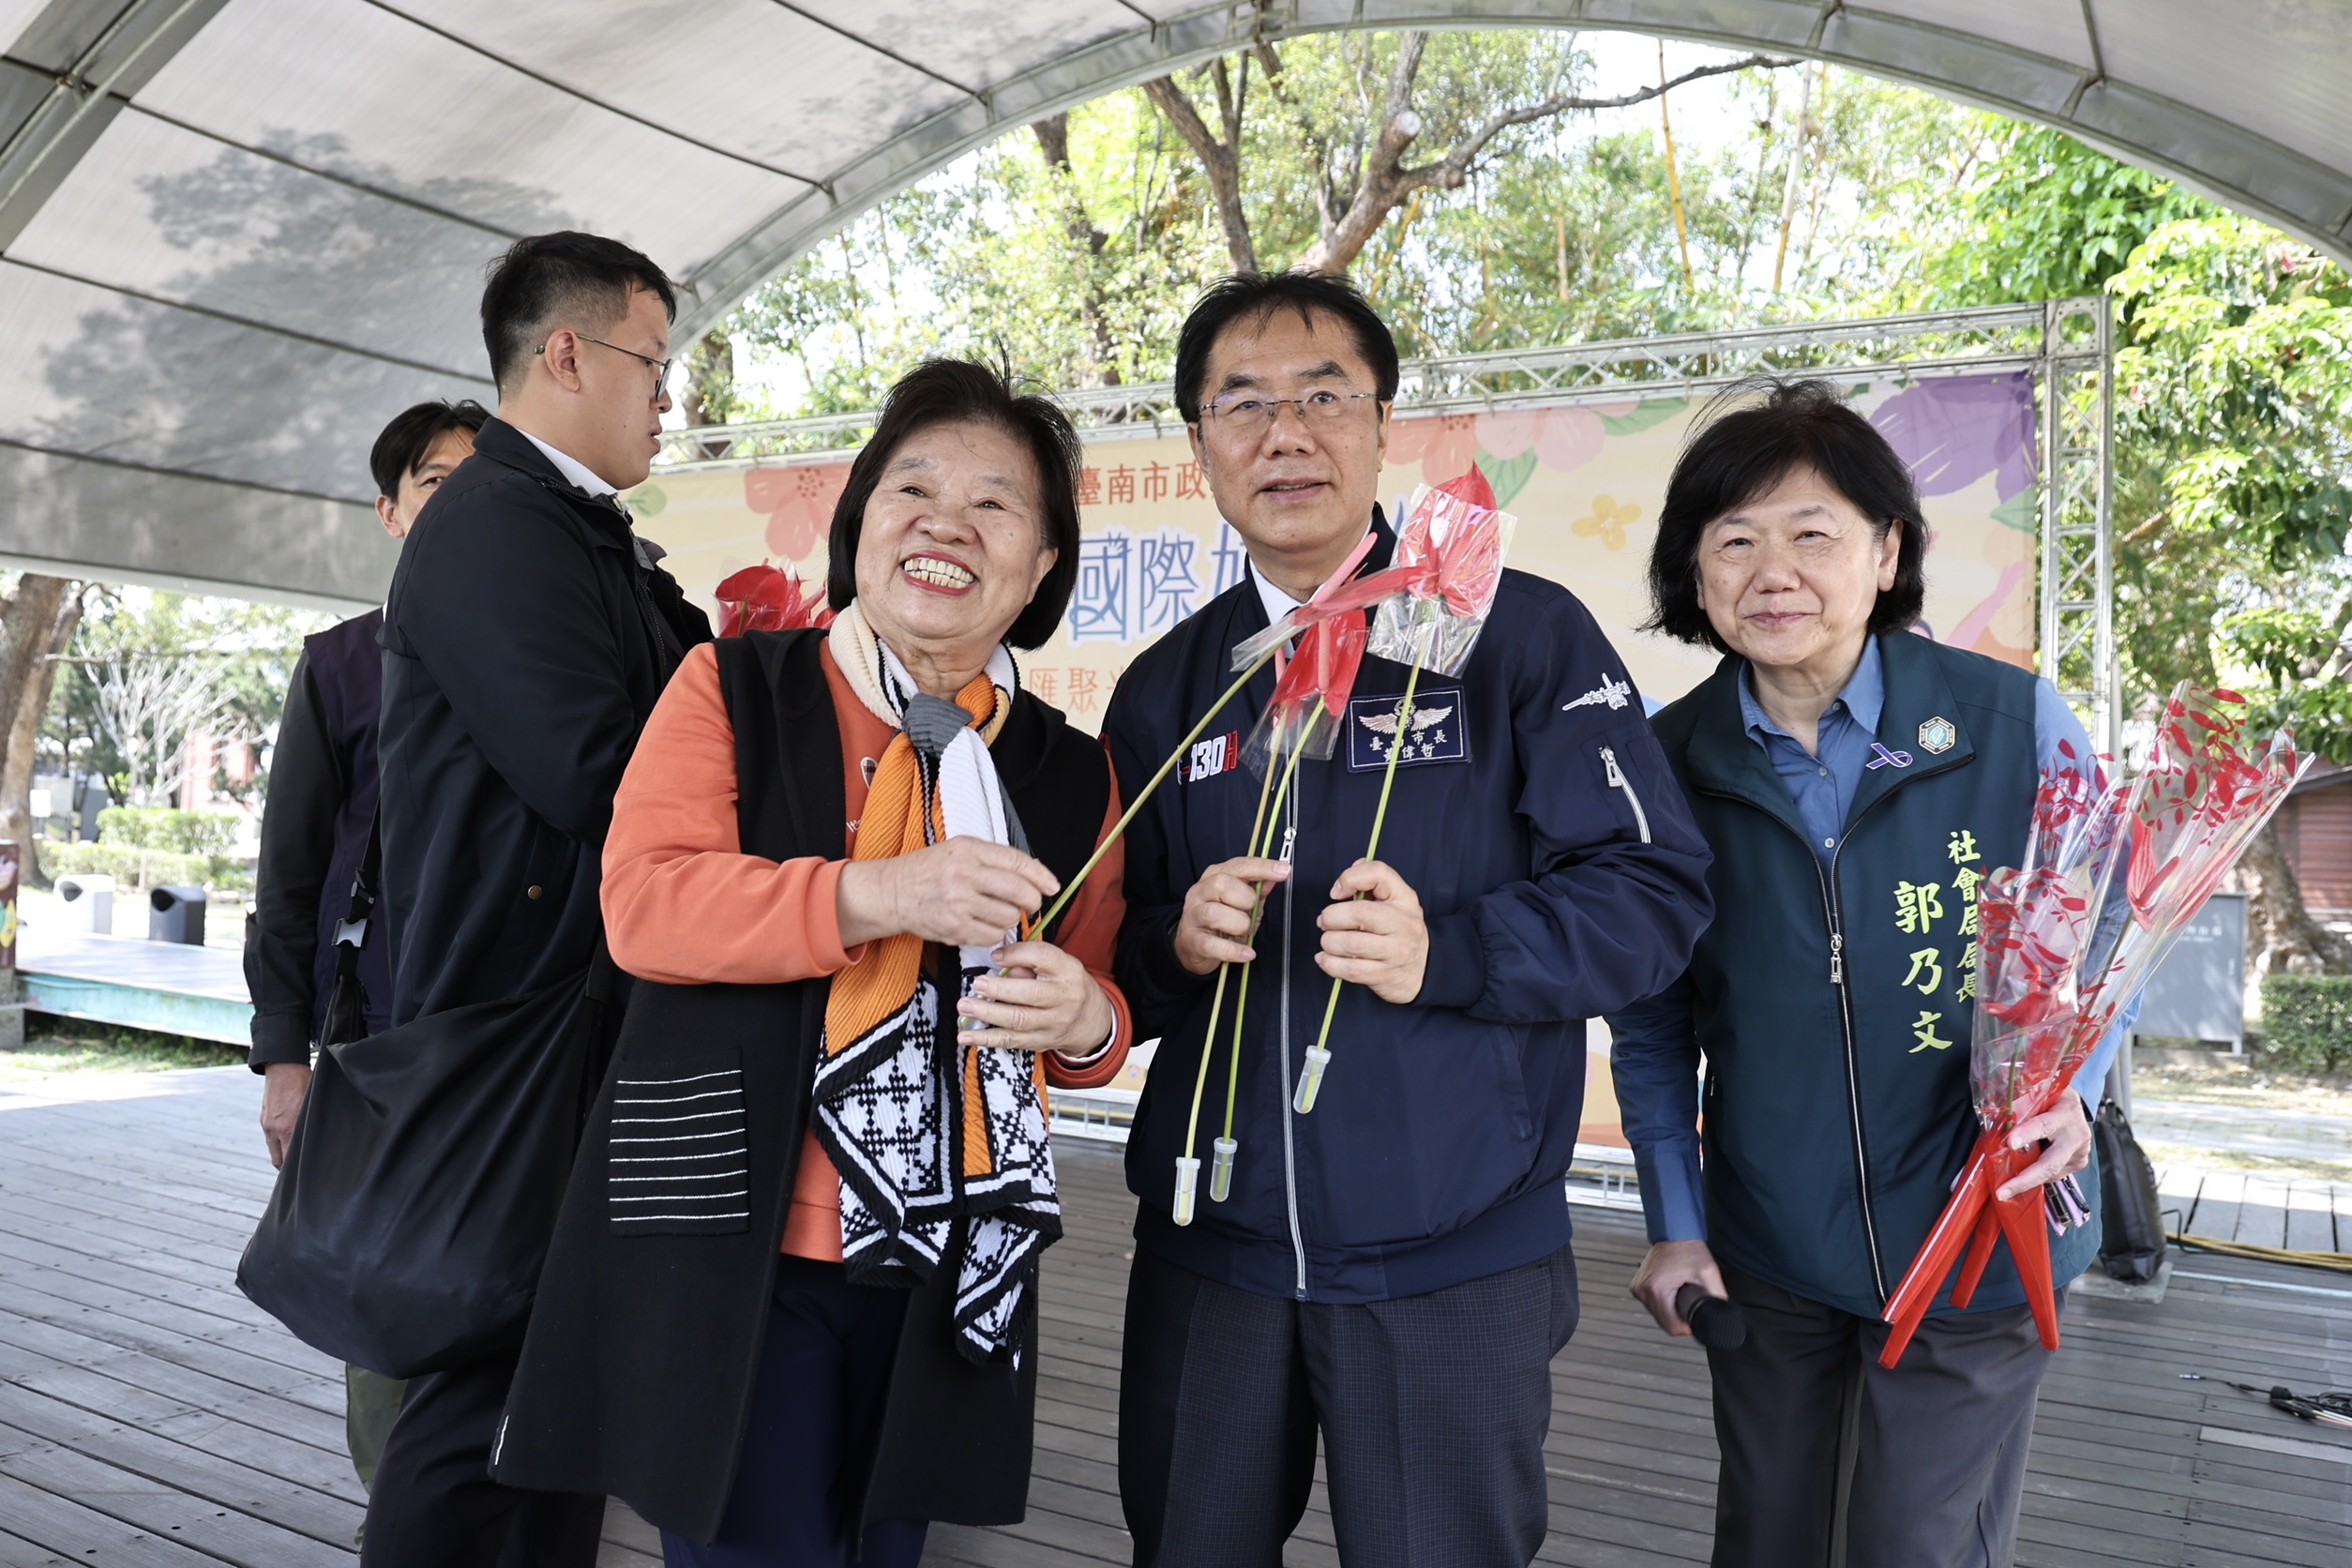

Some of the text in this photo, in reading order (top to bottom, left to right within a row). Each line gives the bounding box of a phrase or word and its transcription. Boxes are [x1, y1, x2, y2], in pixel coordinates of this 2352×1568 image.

[1079, 460, 1214, 505] 臺南市政
[1893, 881, 1953, 1054] 郭乃文
